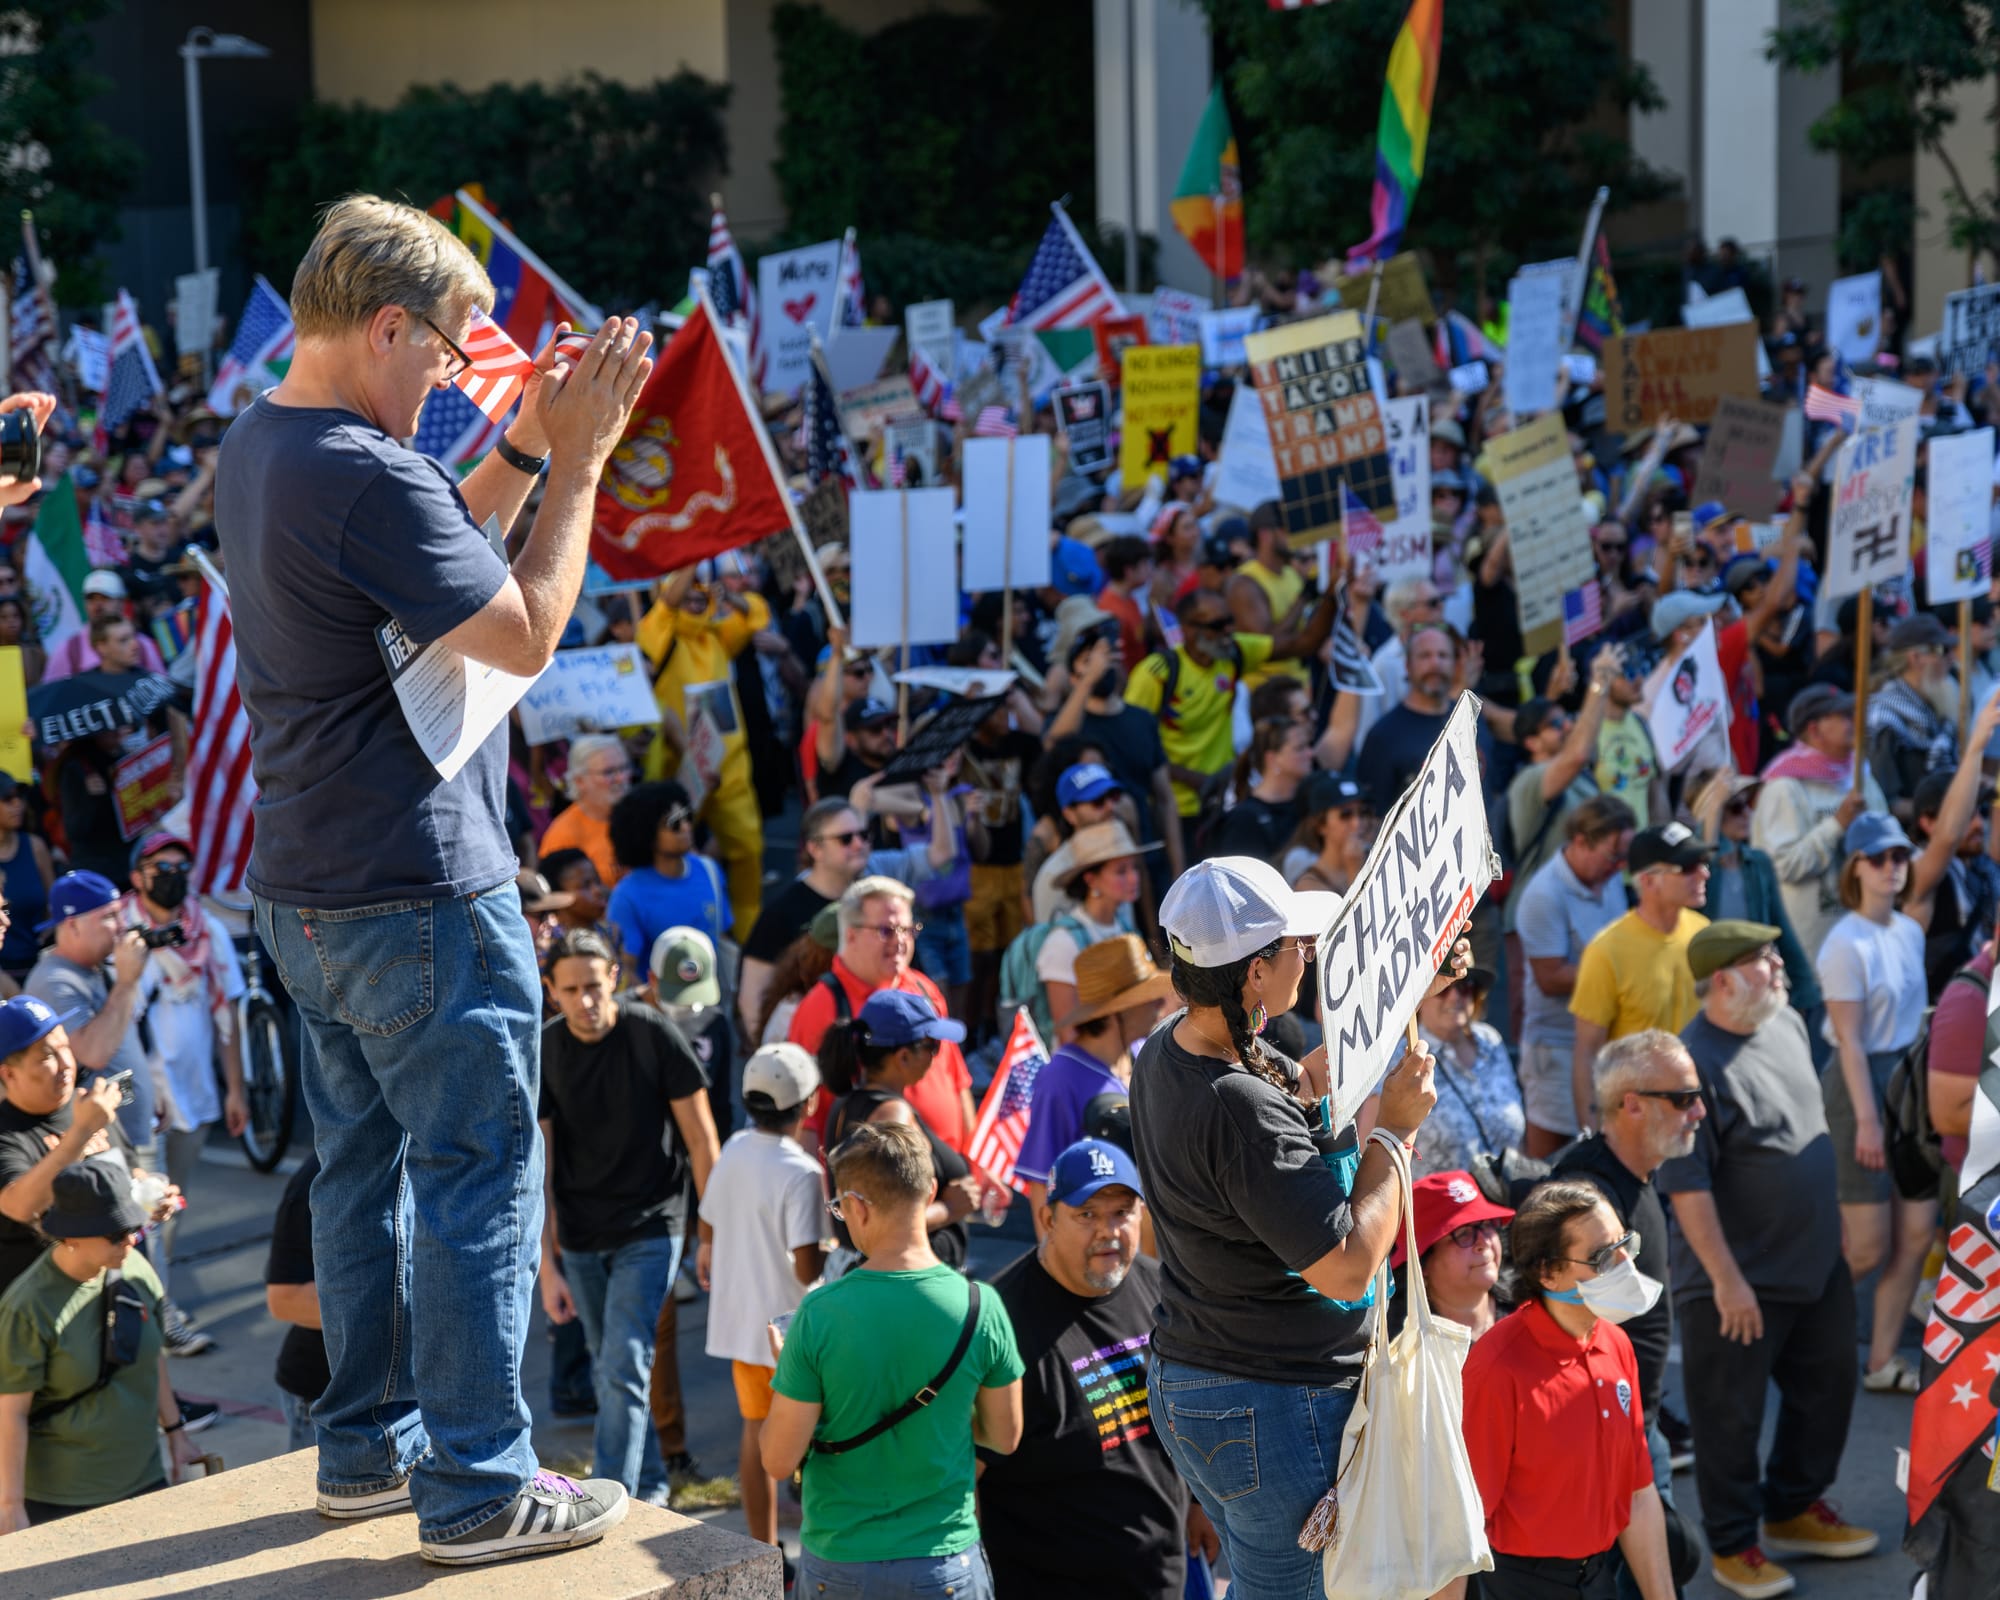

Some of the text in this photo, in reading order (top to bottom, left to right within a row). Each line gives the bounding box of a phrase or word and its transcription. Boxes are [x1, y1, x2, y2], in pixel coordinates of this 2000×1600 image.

[1256, 340, 1361, 385] THIEF
[1272, 396, 1375, 444] TRAMP
[1279, 426, 1381, 474] TRUMP
[1324, 739, 1466, 1012] CHINGA
[1432, 896, 1472, 968] TRUMP
[1338, 827, 1465, 1090] MADRE!
[1087, 1149, 1116, 1176] LA
